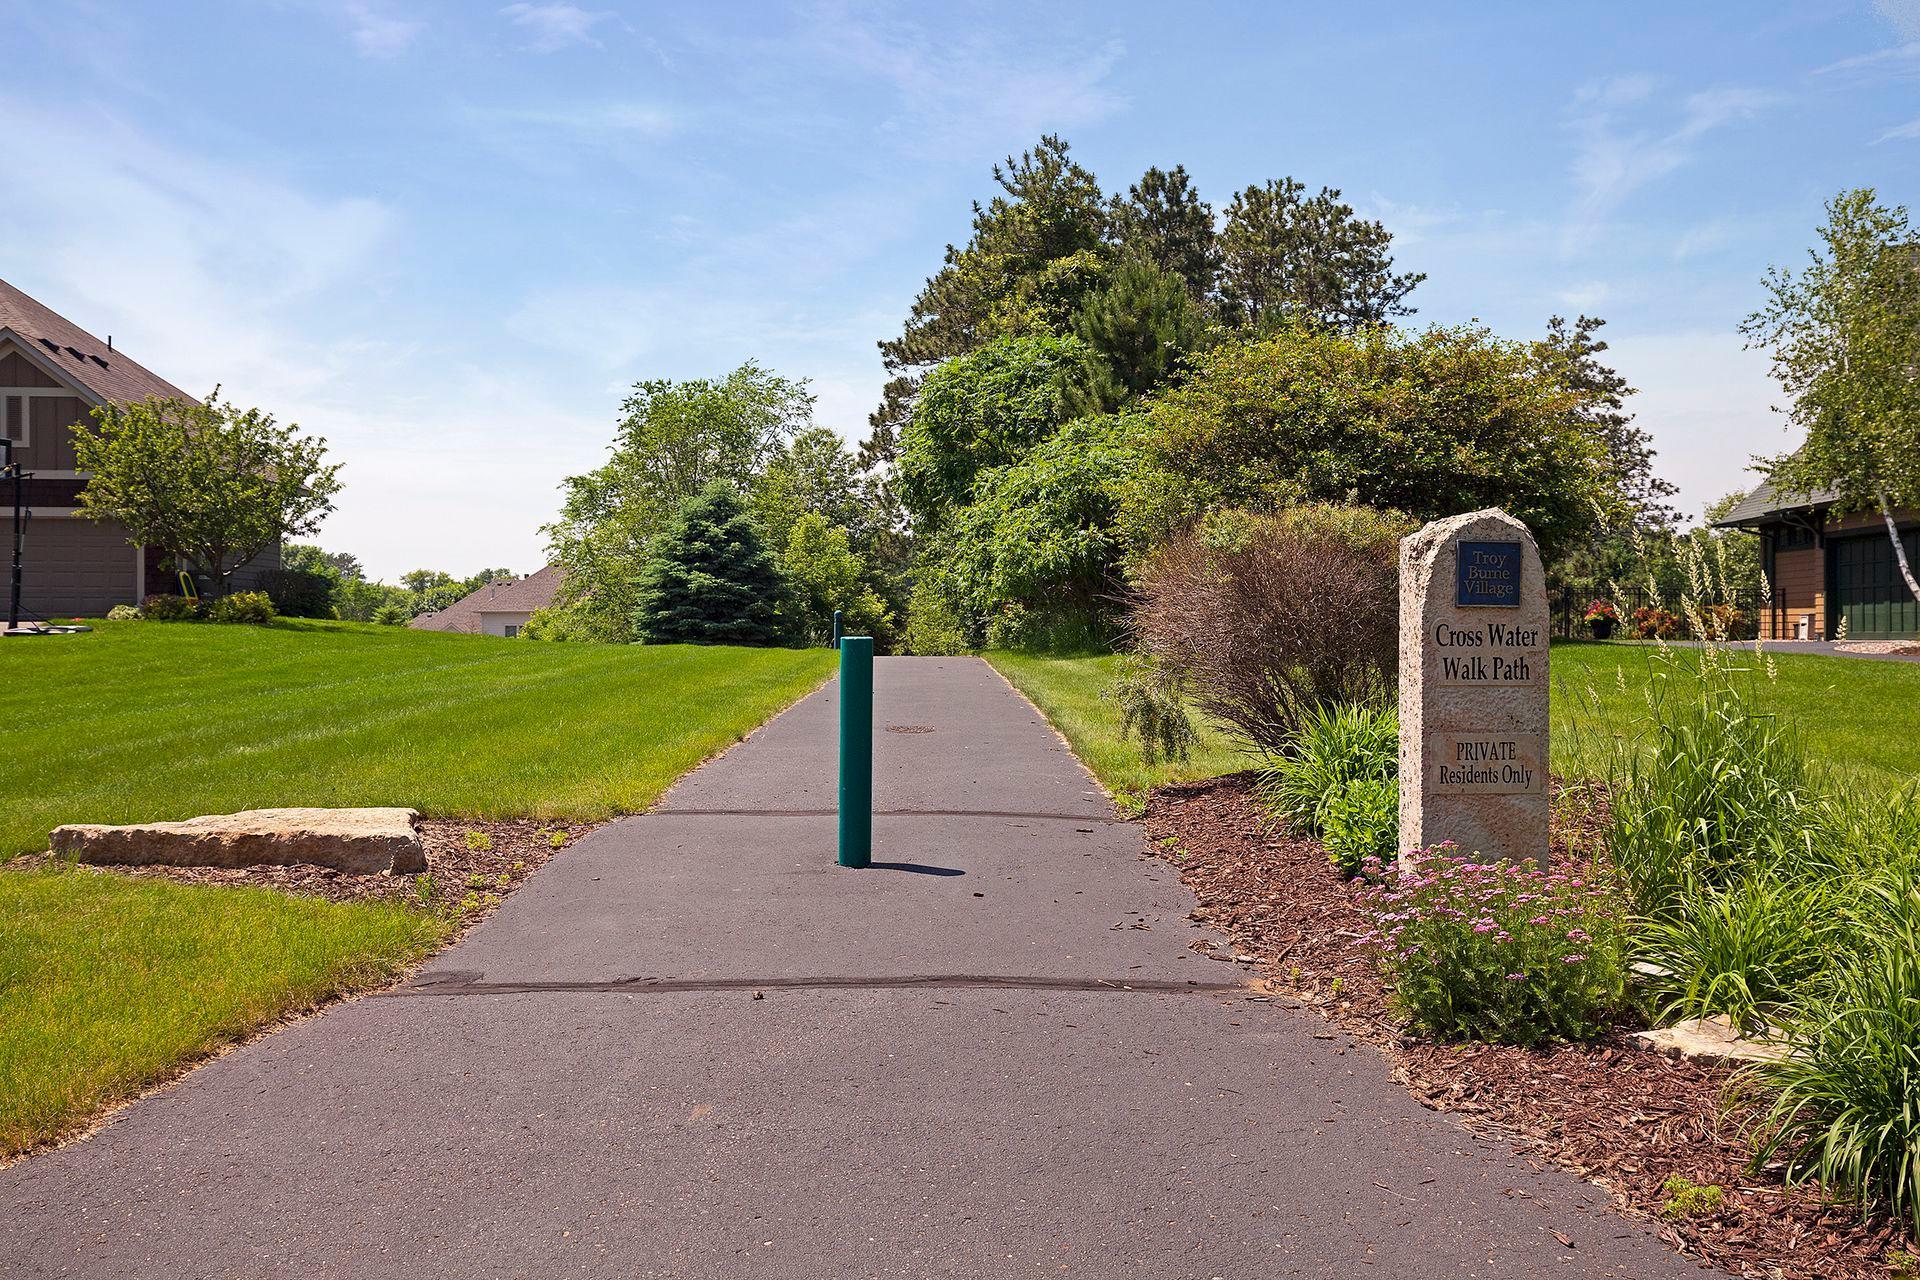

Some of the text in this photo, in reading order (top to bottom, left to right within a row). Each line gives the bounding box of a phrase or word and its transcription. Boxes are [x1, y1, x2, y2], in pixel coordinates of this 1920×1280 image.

[1473, 551, 1507, 568] Troy
[1464, 580, 1514, 598] Village
[1435, 623, 1538, 647] Cross Water
[1443, 656, 1530, 680] Walk Path
[1456, 742, 1516, 761] PRIVATE
[1439, 764, 1532, 789] Residents Only
